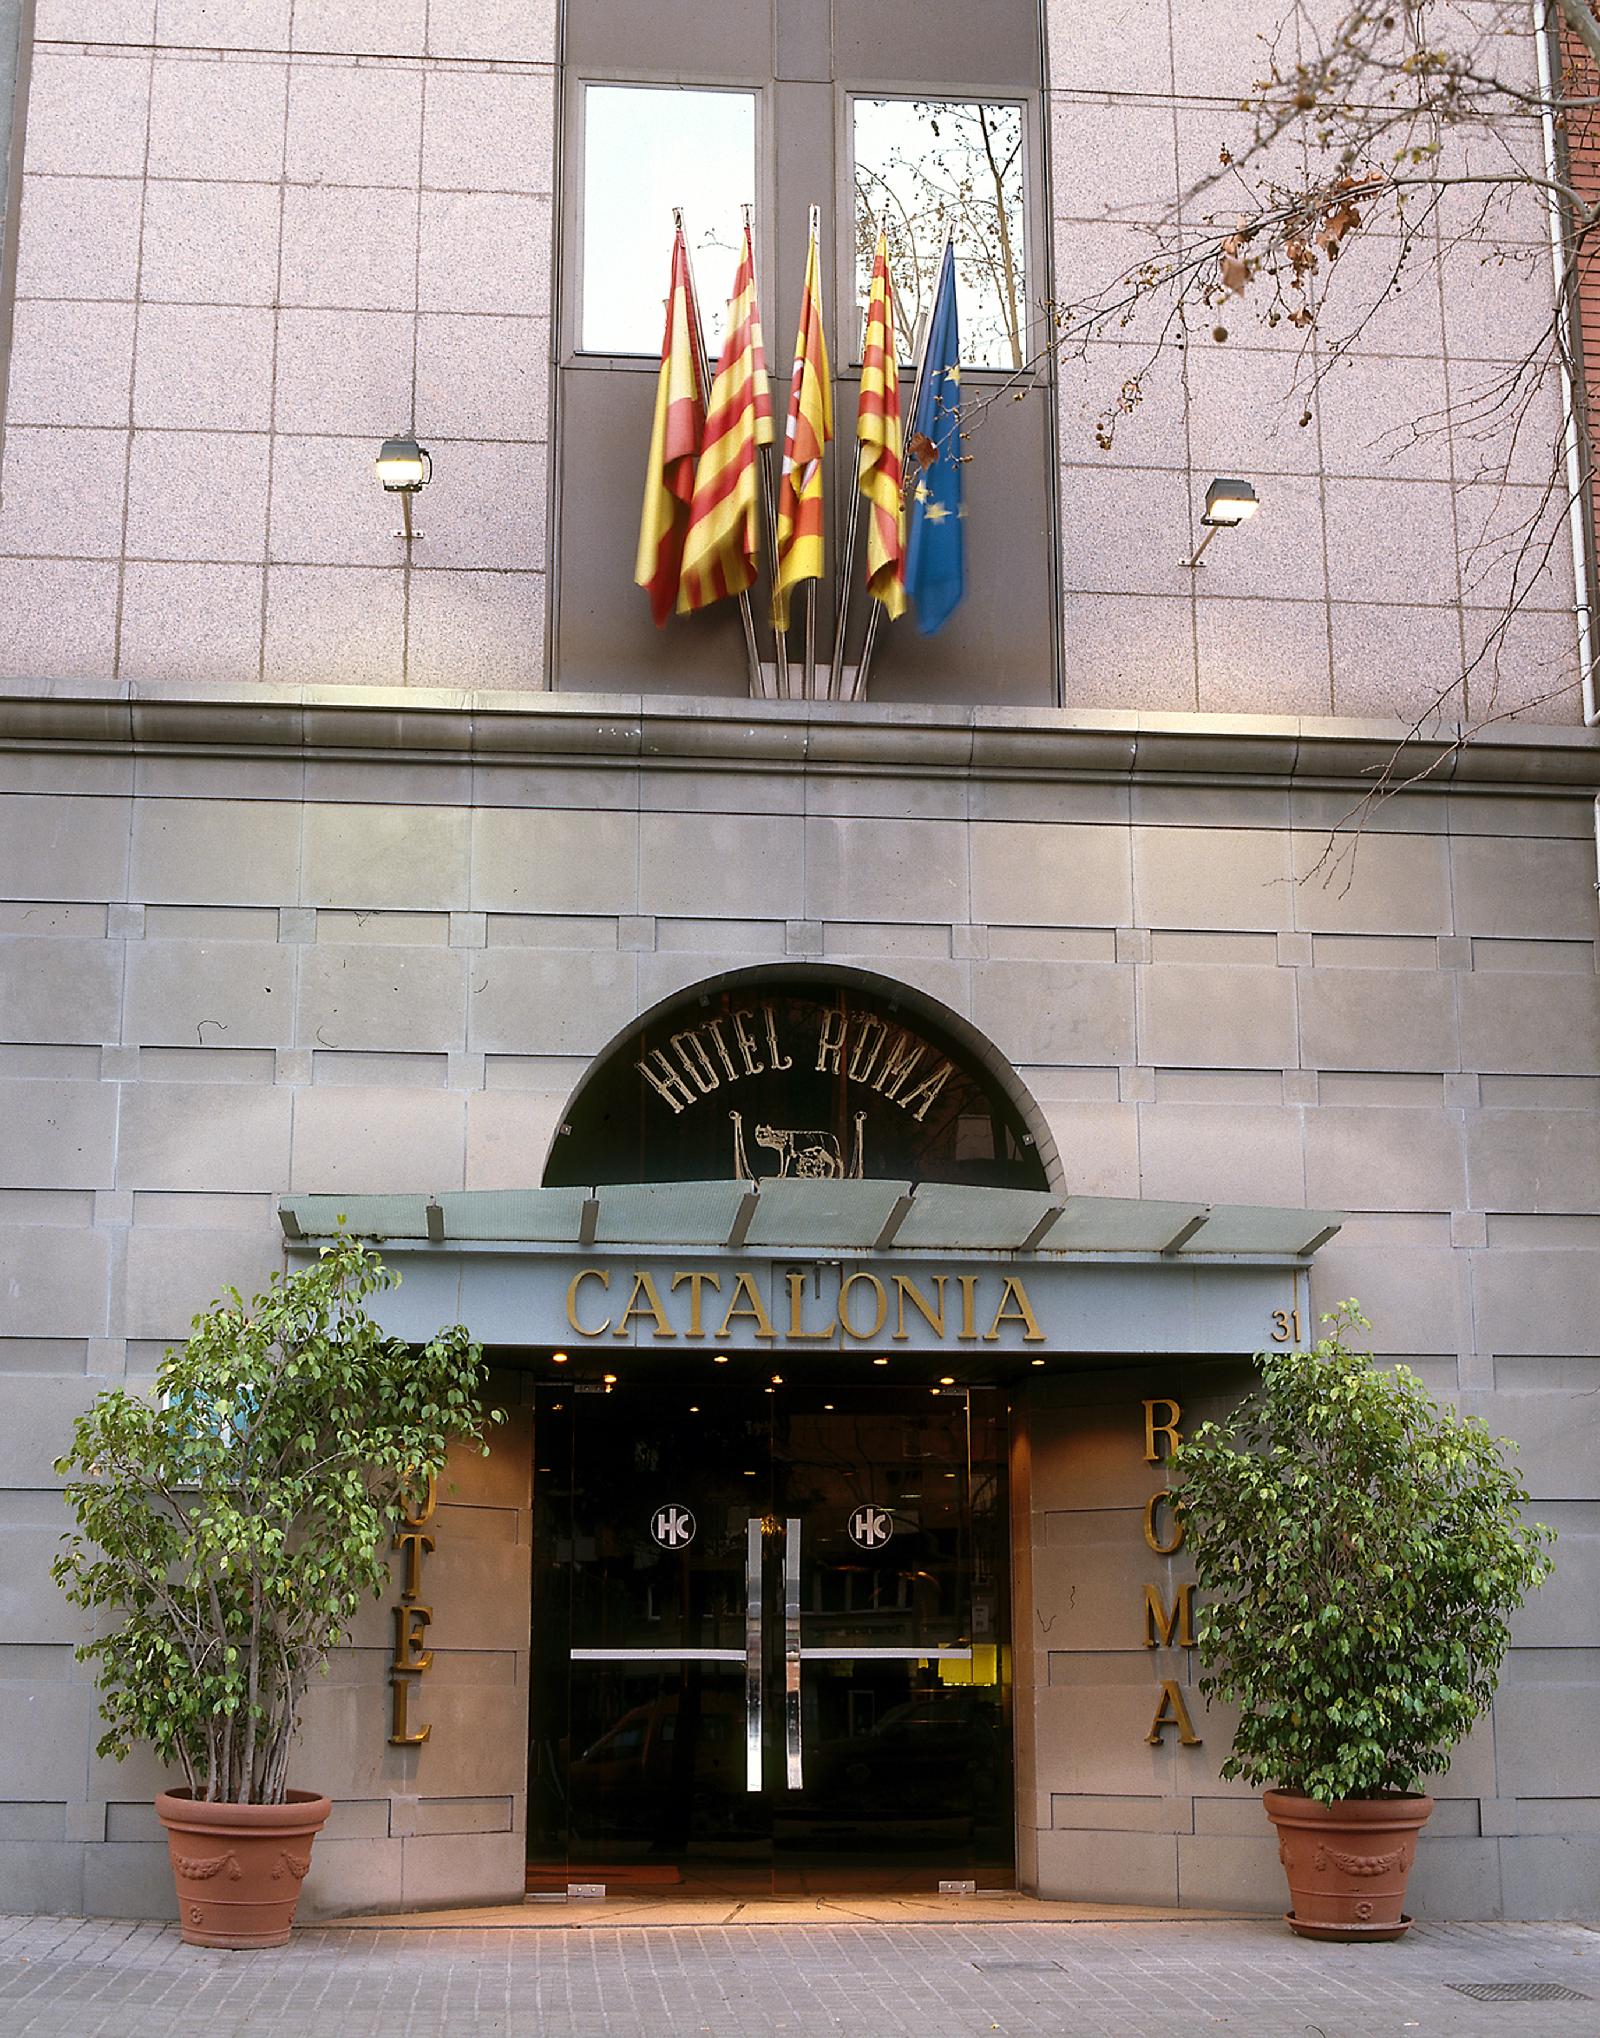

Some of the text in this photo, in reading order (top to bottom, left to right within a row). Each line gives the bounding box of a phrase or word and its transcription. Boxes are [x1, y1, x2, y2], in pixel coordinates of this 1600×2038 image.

[634, 1008, 953, 1122] HOTEL ROMA
[566, 1269, 1047, 1341] CATALONIA
[1271, 1310, 1301, 1343] 31
[388, 1446, 437, 1745] OTEL
[1142, 1398, 1203, 1746] ROMA
